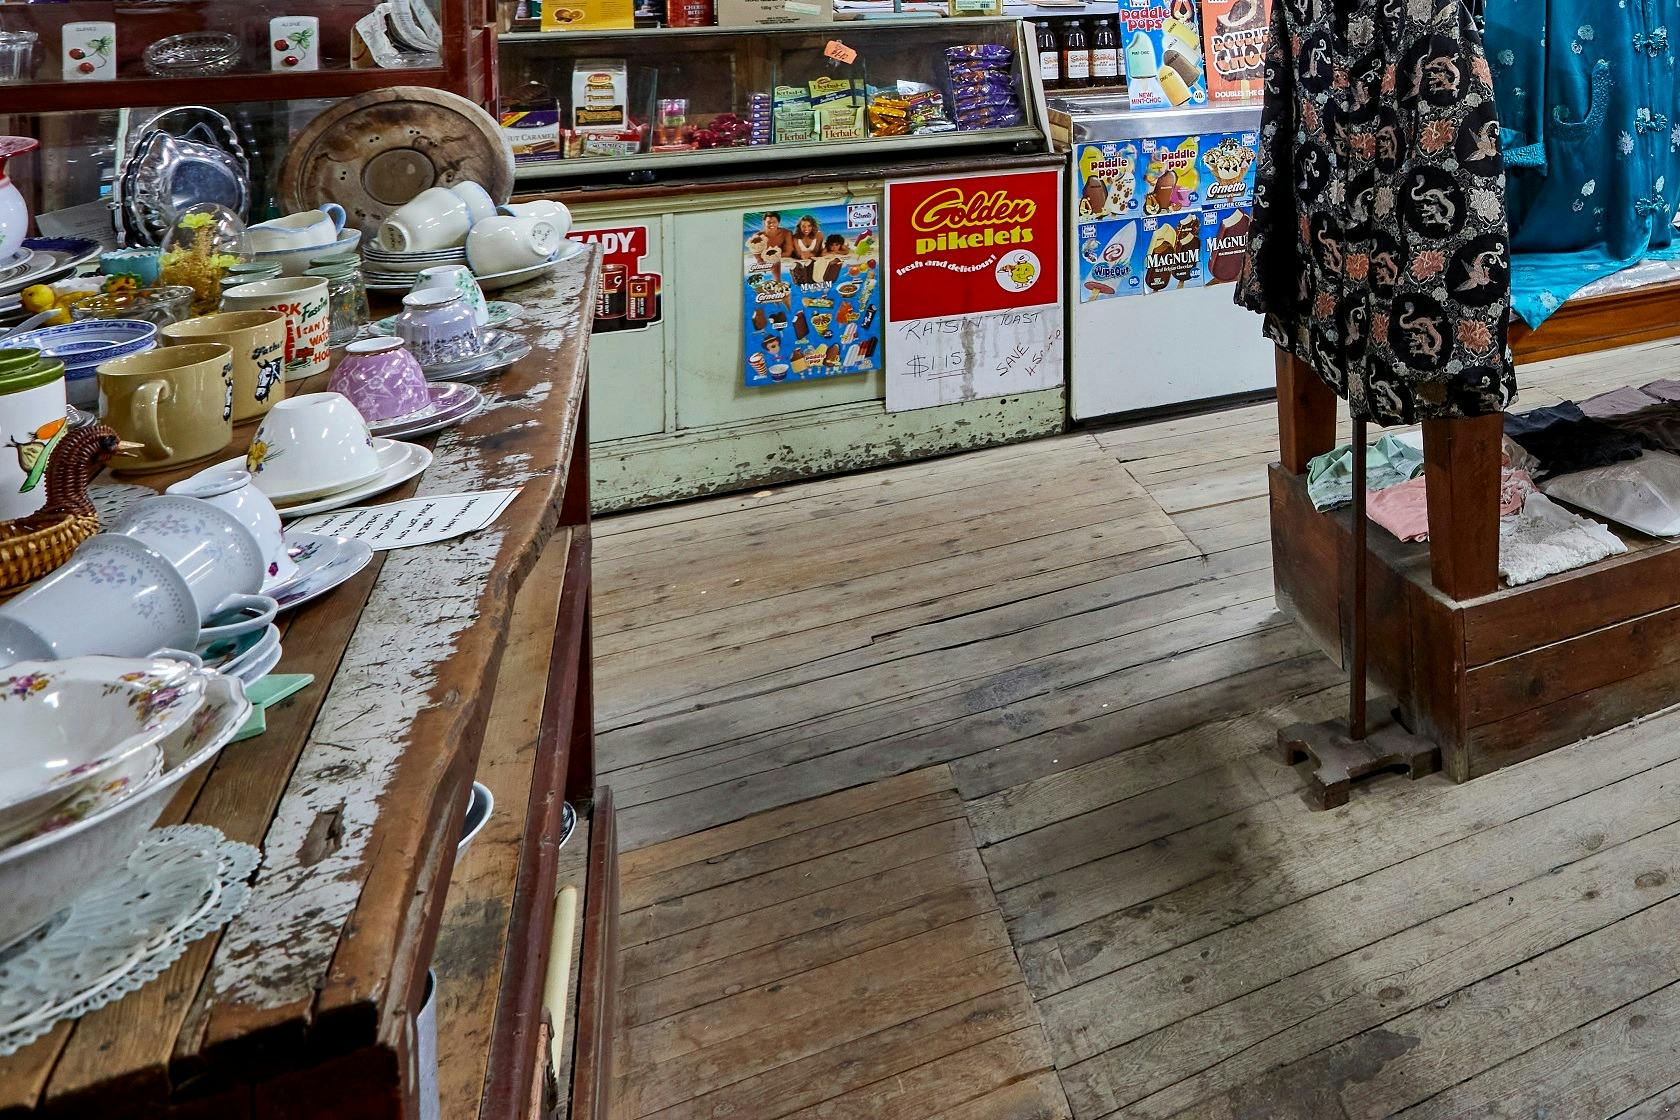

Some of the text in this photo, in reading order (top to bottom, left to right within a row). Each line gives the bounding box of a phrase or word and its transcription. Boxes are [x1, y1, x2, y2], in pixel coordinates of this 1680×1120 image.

[1121, 7, 1171, 21] paddle
[1127, 18, 1163, 32] pops
[522, 133, 556, 141] CARAMEL
[779, 130, 816, 142] Herbal-C
[825, 128, 861, 139] Herbal-C
[1161, 149, 1196, 161] paddle
[1091, 157, 1127, 170] paddle
[1168, 159, 1188, 169] pop
[1098, 167, 1119, 179] pop
[1208, 182, 1246, 198] Cornetto
[912, 188, 1036, 231] Golden
[1206, 232, 1248, 252] MAGNU
[1147, 249, 1199, 268] MAGNUM
[896, 254, 998, 277] fresh and delicious!
[800, 281, 832, 291] MAGNUM
[755, 292, 786, 302] Cornetto
[995, 344, 1029, 376] SAVE
